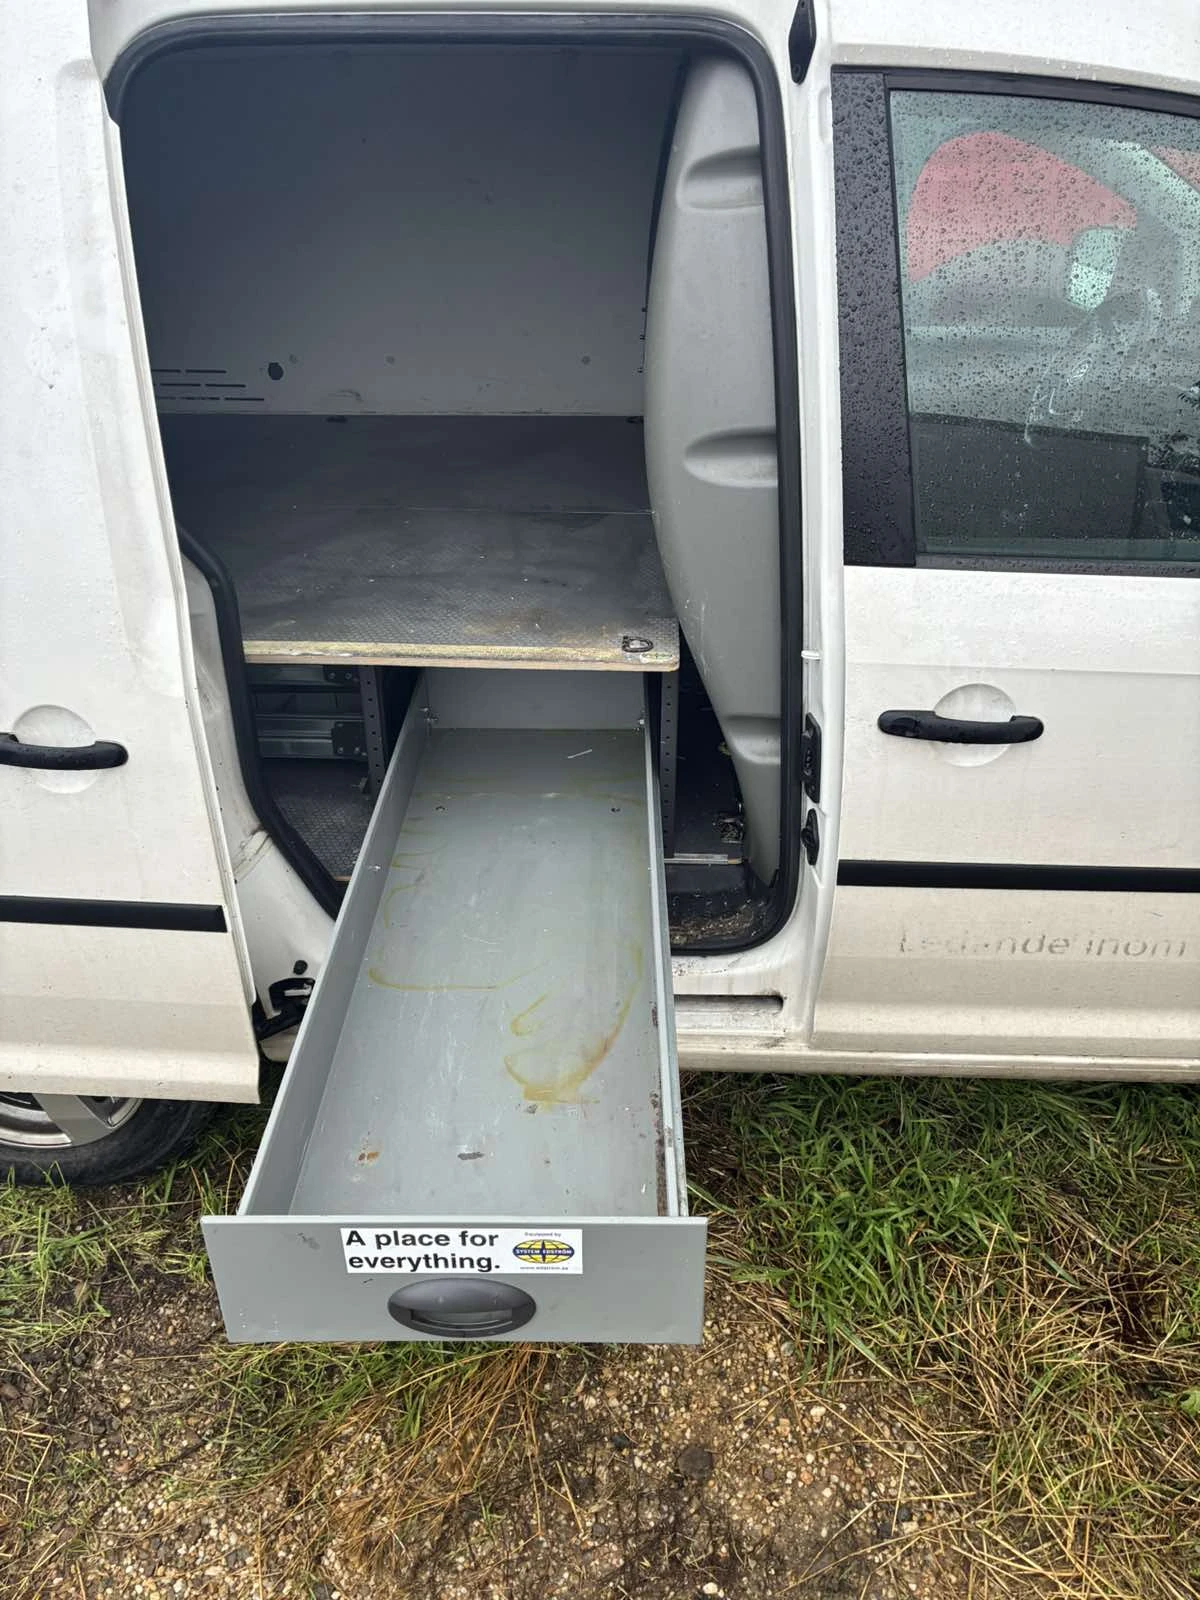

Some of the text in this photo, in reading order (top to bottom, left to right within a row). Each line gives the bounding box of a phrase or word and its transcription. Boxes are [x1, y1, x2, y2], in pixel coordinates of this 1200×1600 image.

[1085, 934, 1188, 956] inom
[346, 1230, 499, 1249] A place for
[349, 1253, 500, 1273] everything.
